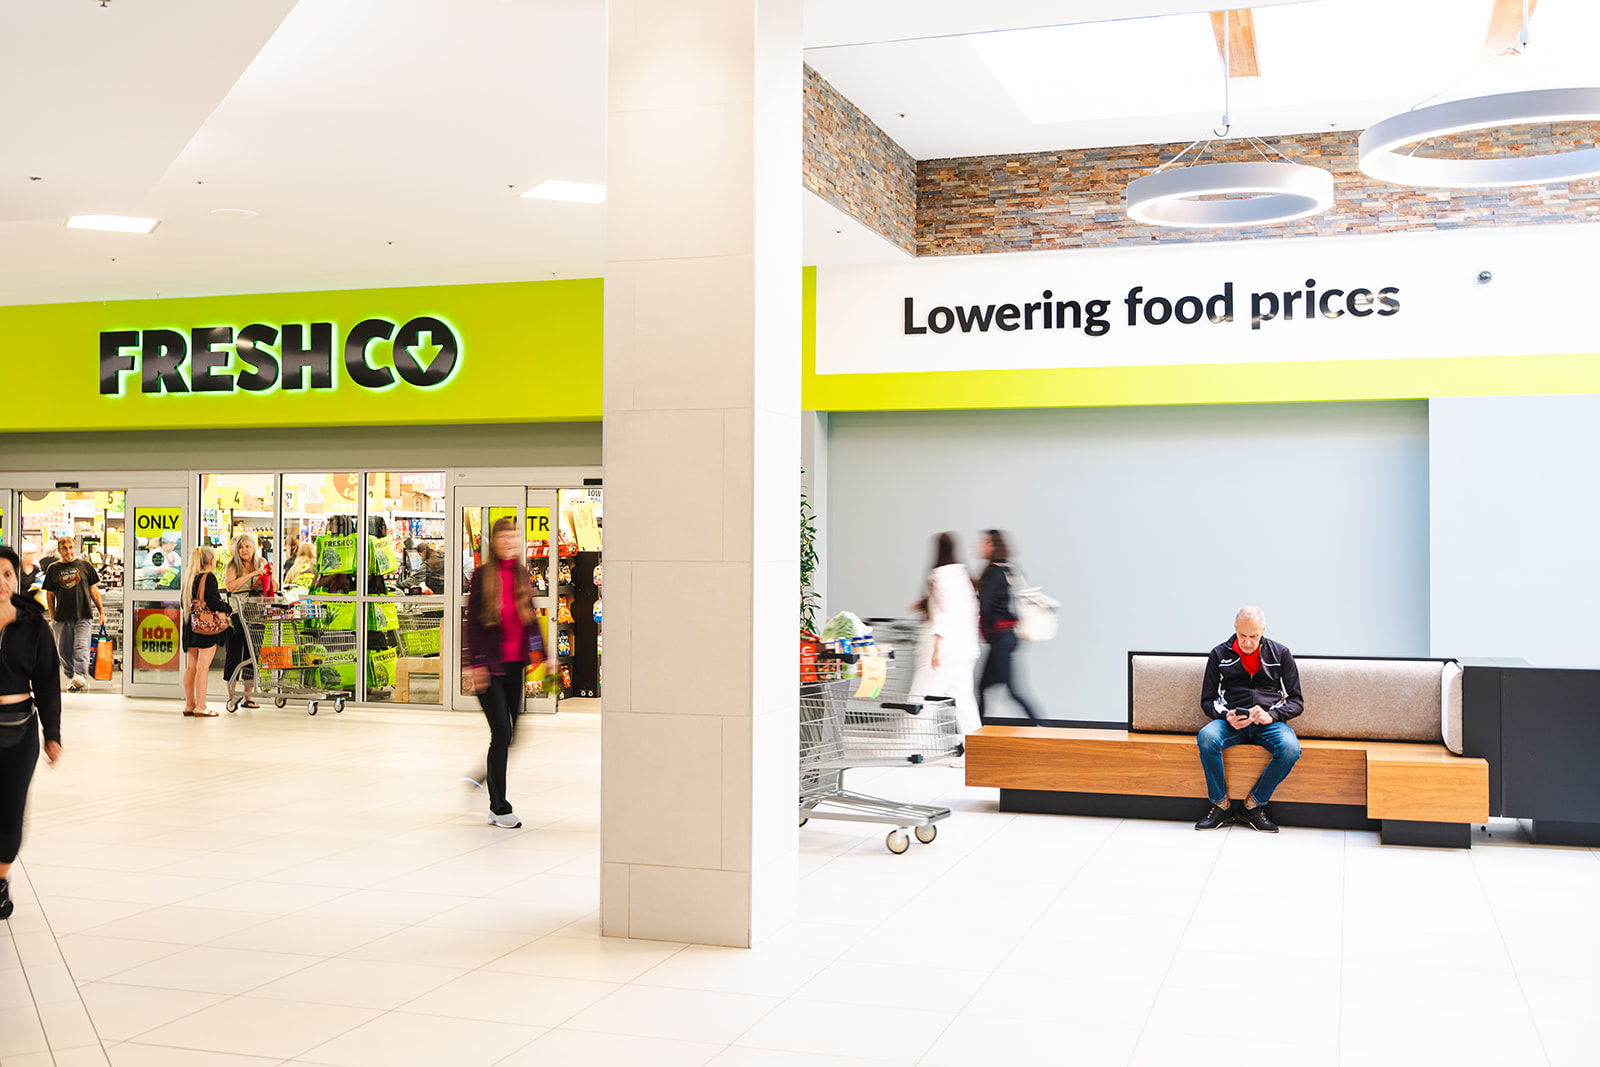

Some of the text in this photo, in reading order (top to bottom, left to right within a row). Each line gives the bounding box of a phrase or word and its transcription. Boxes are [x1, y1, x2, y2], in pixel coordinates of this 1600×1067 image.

[903, 278, 1400, 337] Lowering food prices
[100, 322, 332, 394] FRESH
[107, 491, 114, 504] 5
[234, 490, 240, 504] 4
[138, 515, 179, 529] ONLY
[142, 626, 173, 639] HOT
[142, 641, 173, 653] PRICE
